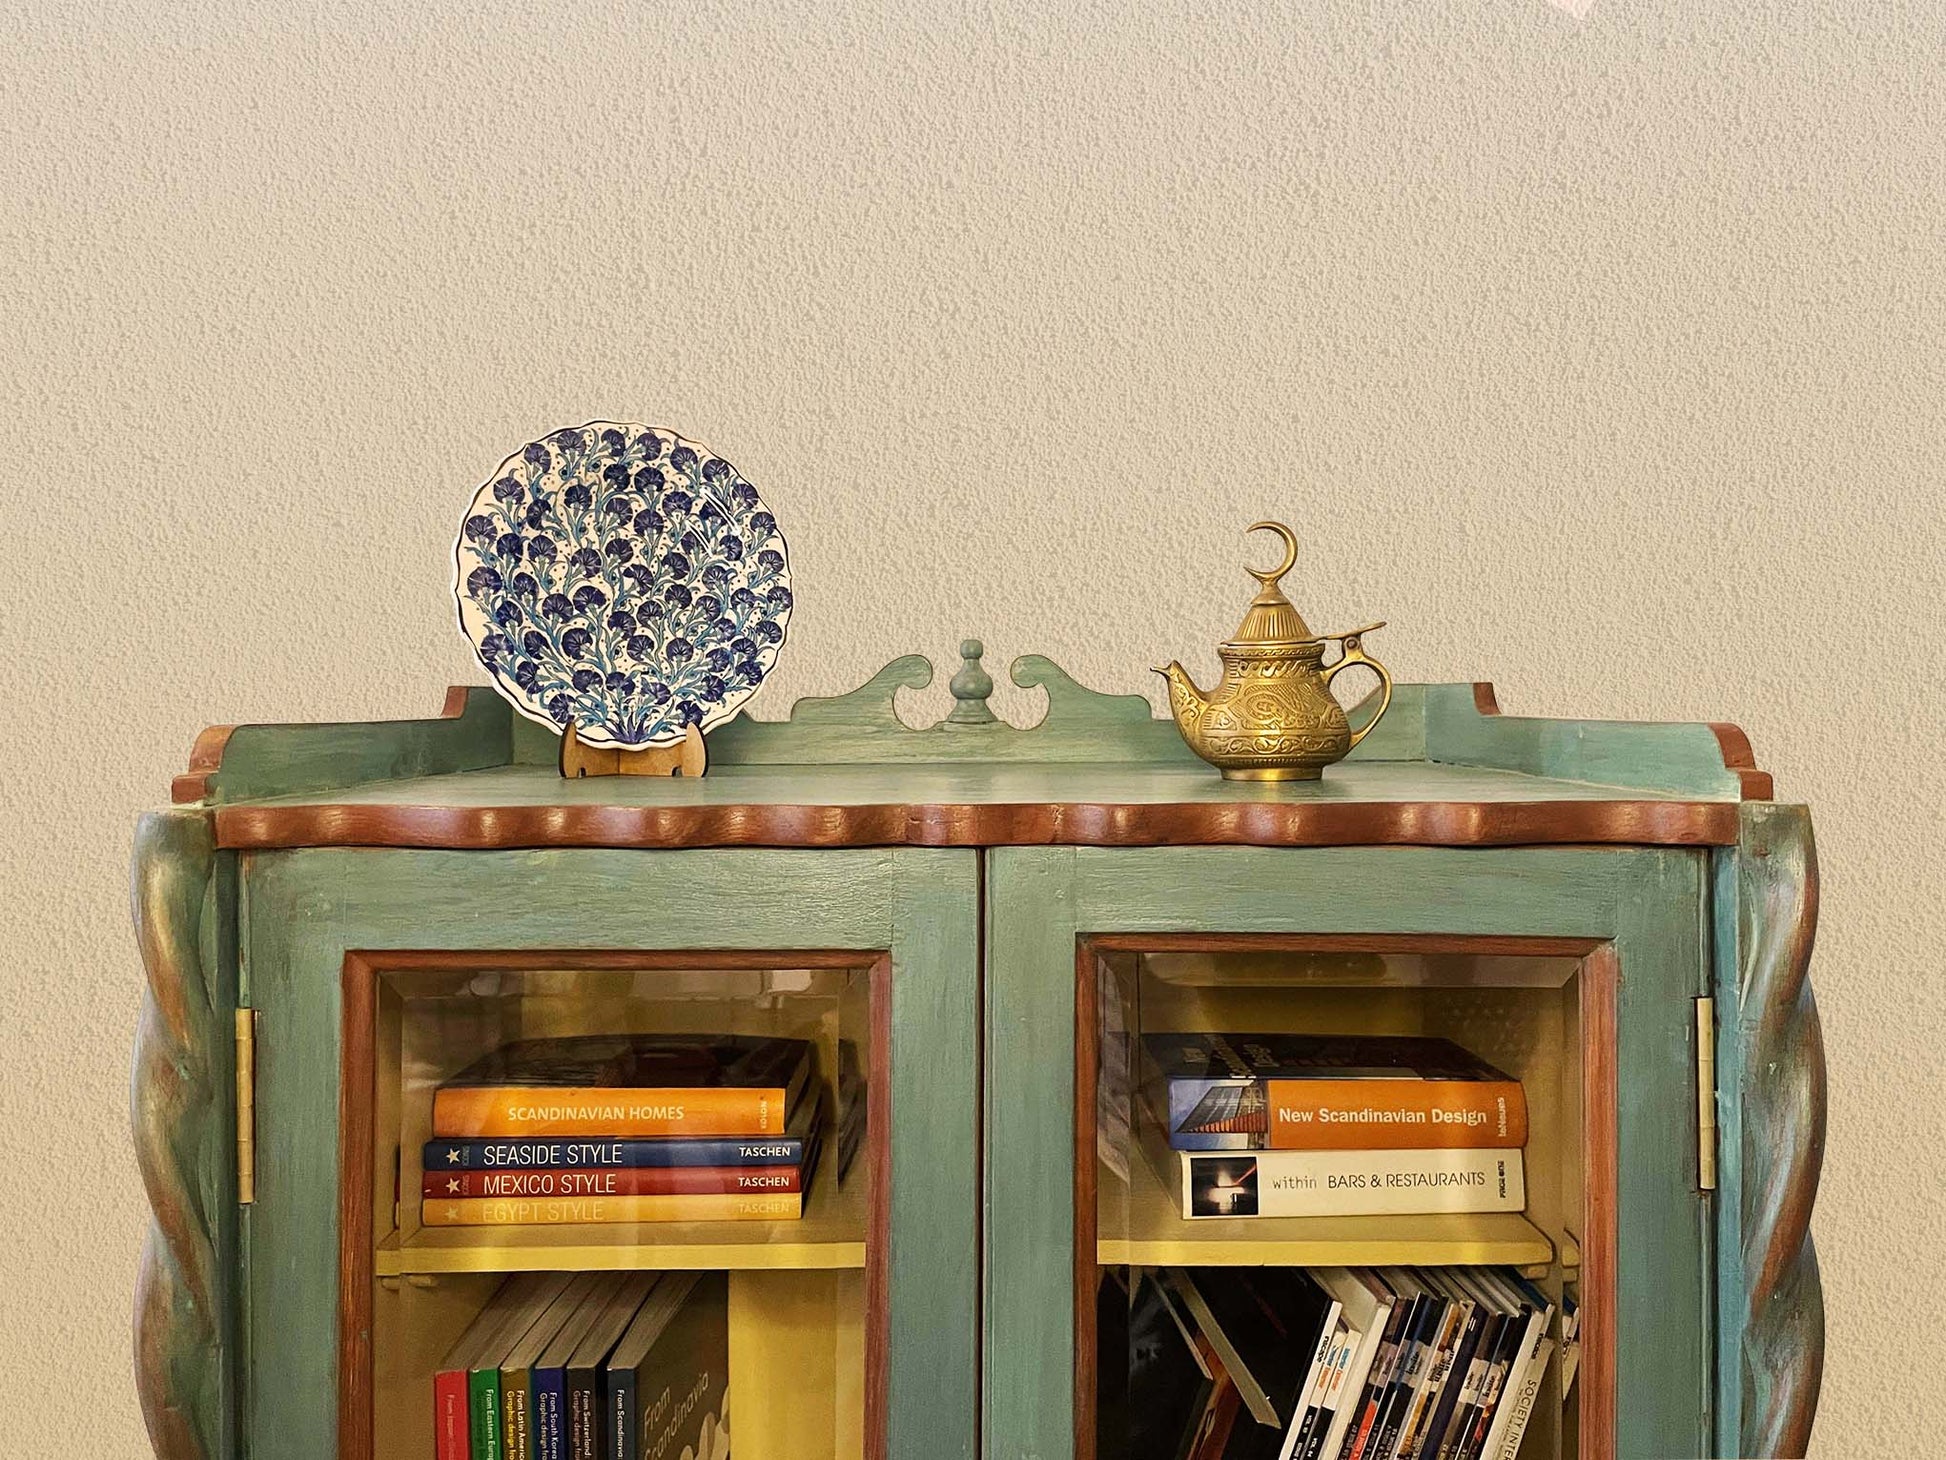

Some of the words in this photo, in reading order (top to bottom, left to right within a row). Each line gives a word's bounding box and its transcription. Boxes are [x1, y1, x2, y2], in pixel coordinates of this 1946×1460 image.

[508, 1107, 625, 1121] SCANDINAVIAN
[629, 1106, 685, 1120] HOMES
[1279, 1108, 1313, 1123] New
[1319, 1108, 1426, 1124] Scandinavian
[1432, 1108, 1487, 1126] Design
[483, 1145, 561, 1165] SEASIDE
[567, 1144, 623, 1164] STYLE
[739, 1147, 791, 1157] TASCHEN
[483, 1175, 554, 1195] MEXICO
[561, 1174, 616, 1193] STYLE
[738, 1177, 790, 1187] TASCHEN
[1273, 1175, 1317, 1190] within
[1328, 1174, 1366, 1189] BARS
[1371, 1175, 1382, 1188] &
[1386, 1171, 1486, 1188] RESTAURANTS
[482, 1202, 541, 1222] EGYPT
[548, 1201, 604, 1221] STYLE
[738, 1203, 790, 1214] TASCHEN
[486, 1389, 494, 1409] From
[506, 1390, 515, 1422] Graphic
[517, 1390, 525, 1410] From
[539, 1392, 548, 1423] Graphic
[583, 1390, 591, 1410] From
[617, 1389, 625, 1409] From
[1515, 1379, 1537, 1429] SOCIETY
[517, 1412, 526, 1431] Latin
[644, 1386, 670, 1440] From
[486, 1410, 495, 1439] Eastern
[507, 1423, 516, 1448] design
[540, 1425, 549, 1449] design
